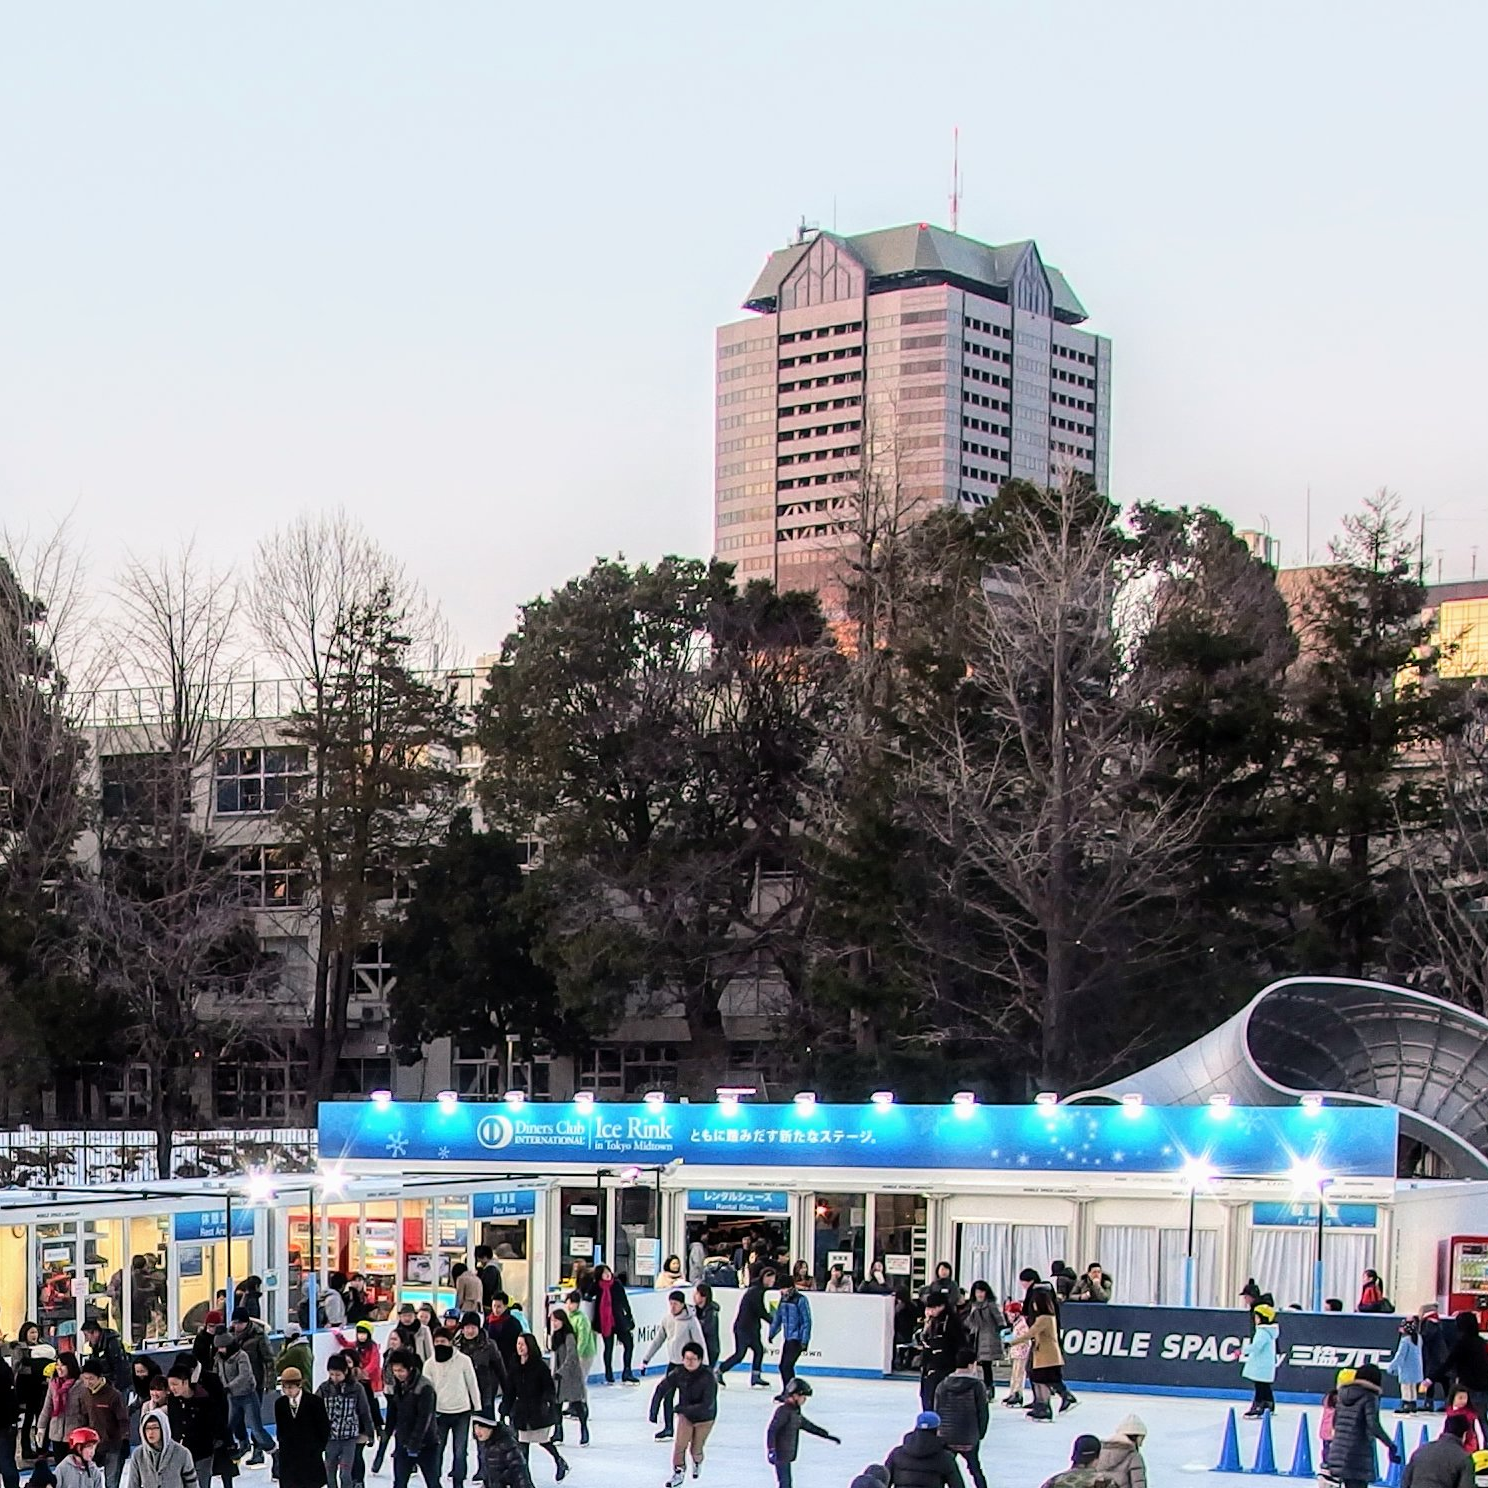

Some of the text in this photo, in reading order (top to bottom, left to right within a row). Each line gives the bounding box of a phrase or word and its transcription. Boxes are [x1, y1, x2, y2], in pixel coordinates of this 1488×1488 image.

[514, 1120, 585, 1135] Diners Club
[596, 1116, 673, 1139] Ice Rink
[514, 1135, 585, 1146] INTERNATIONAL
[594, 1140, 673, 1153] in Tokyo Midtown
[703, 1190, 773, 1201] レンタルシューズ
[1060, 1328, 1152, 1359] OBILE
